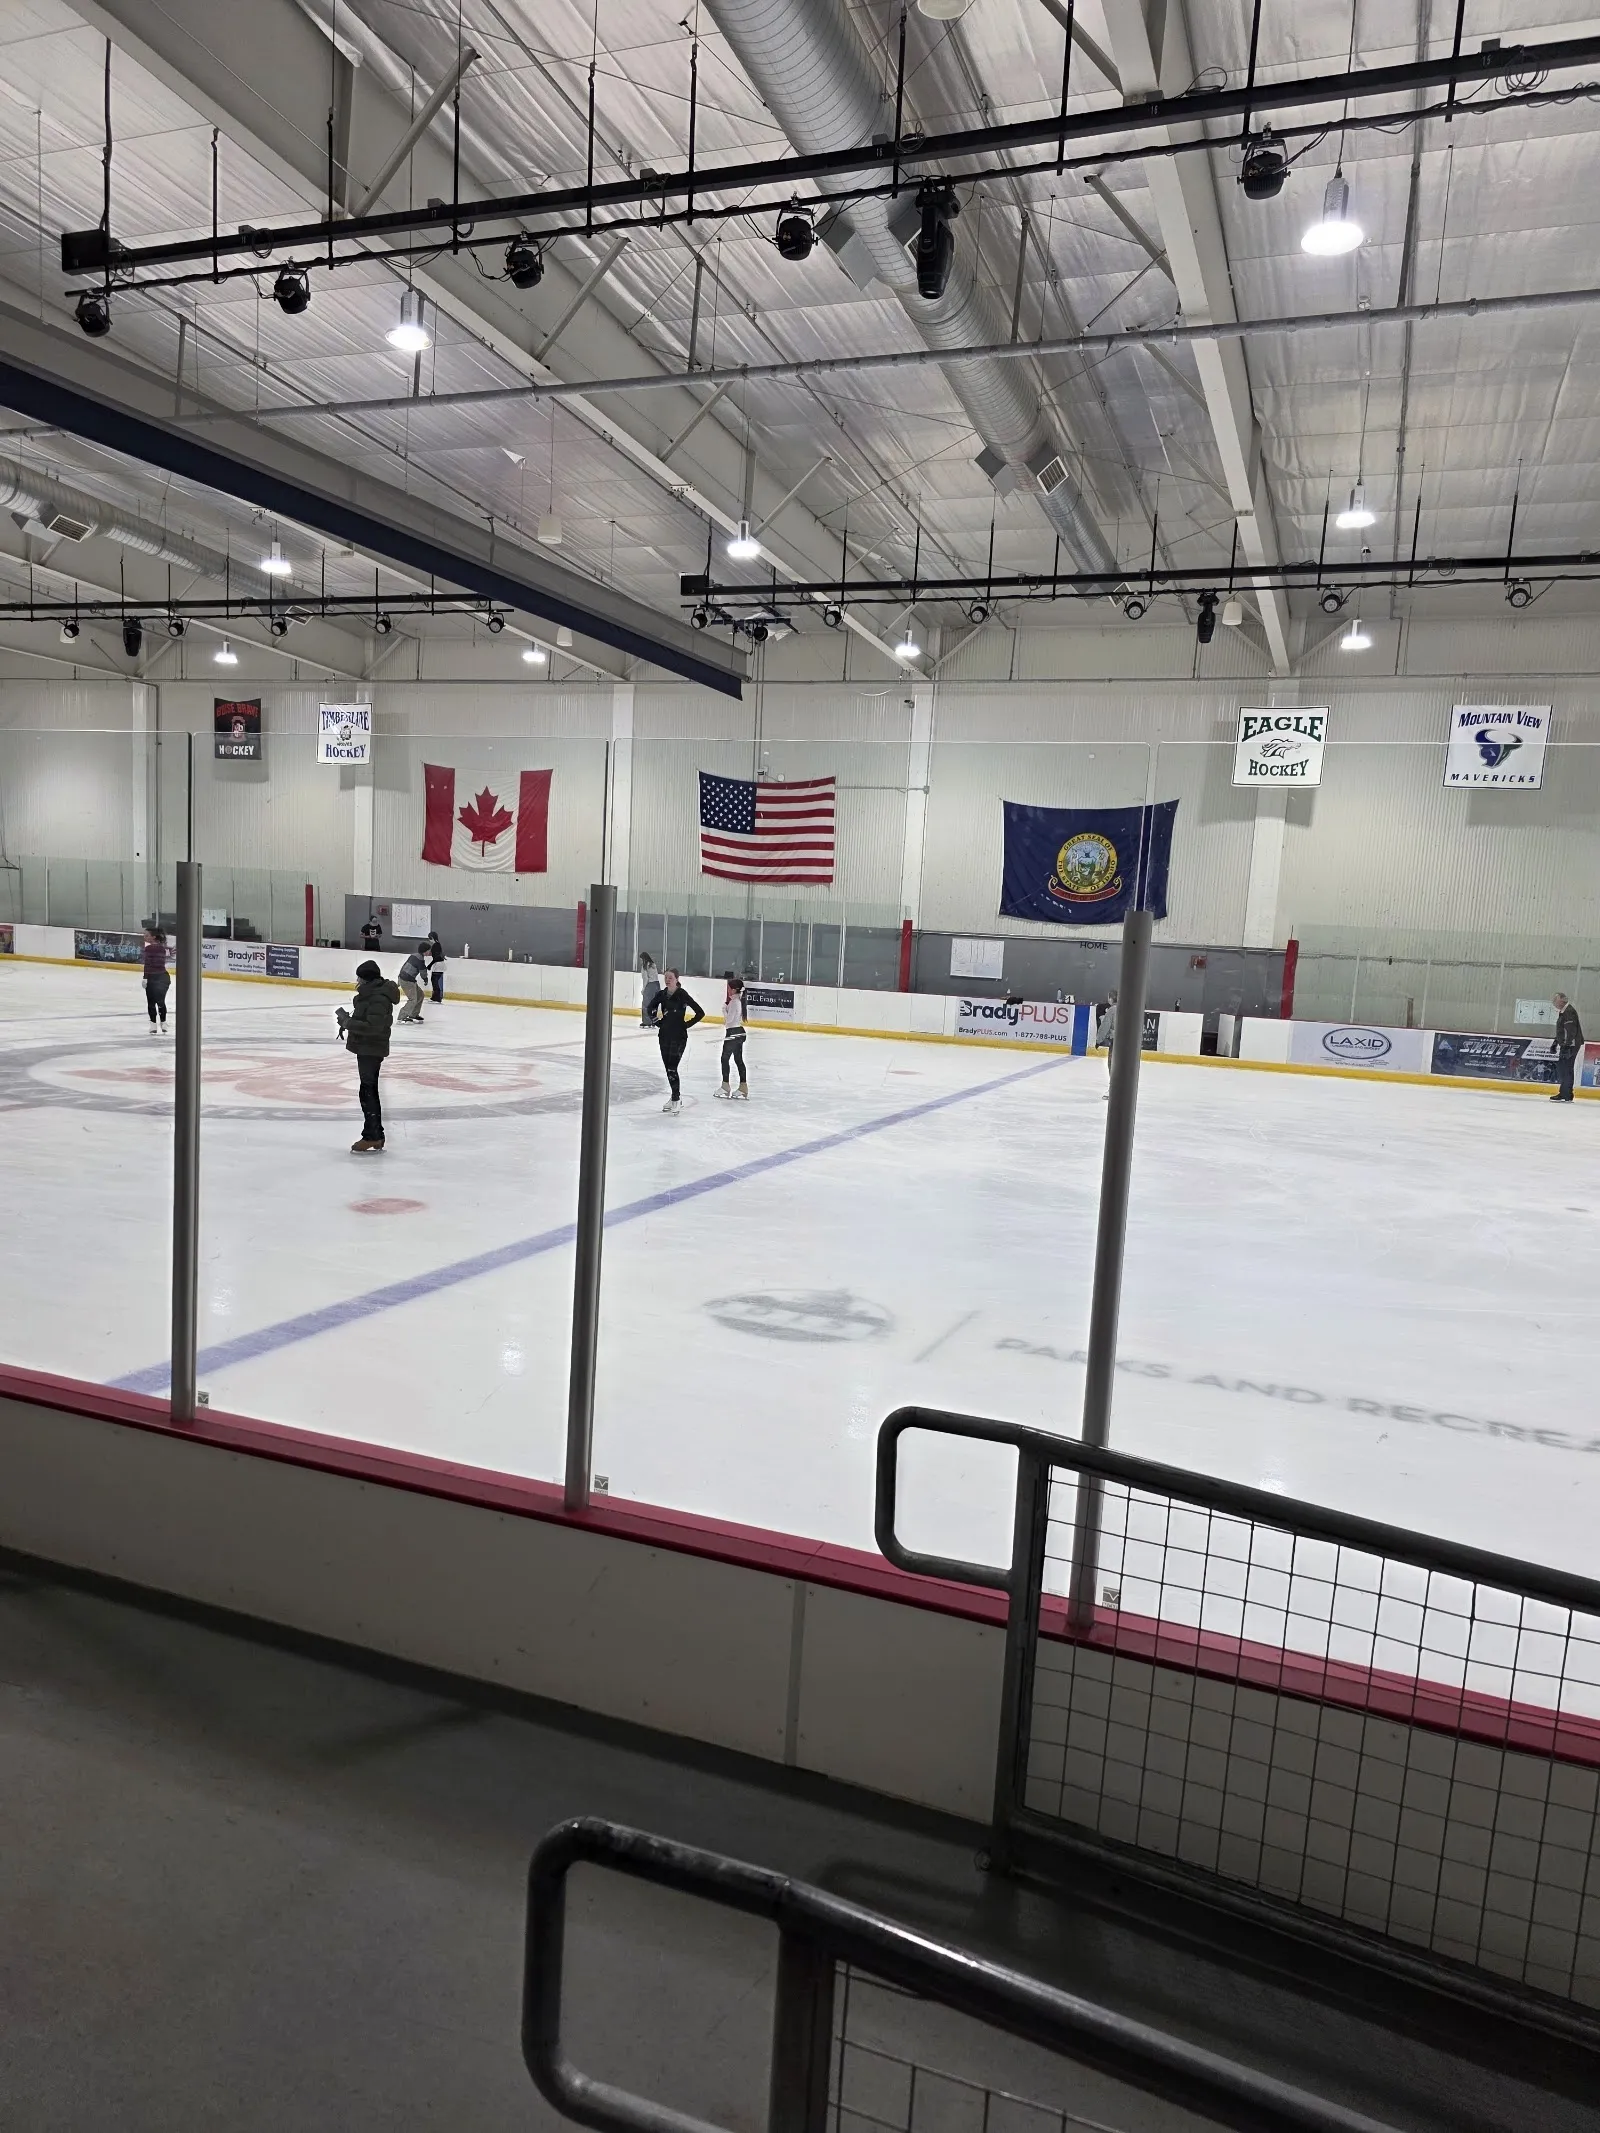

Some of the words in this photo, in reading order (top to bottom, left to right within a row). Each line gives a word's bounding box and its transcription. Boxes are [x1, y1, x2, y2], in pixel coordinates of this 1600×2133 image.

[321, 711, 370, 731] TIMBERLINE
[1458, 712, 1514, 728] MOUNTAIN
[1517, 711, 1543, 729] VIEW
[1241, 716, 1324, 743] EAGLE
[219, 744, 255, 756] HOCKEY
[325, 744, 367, 758] HOCKEY
[1247, 758, 1310, 777] HOCKEY
[1450, 773, 1536, 783] MAVERICKS
[469, 904, 490, 912] AWAY
[1079, 941, 1108, 950] HOME
[958, 1027, 1008, 1038] BradyPLUS.com
[1330, 1035, 1384, 1048] LAXID
[1459, 1041, 1521, 1056] SKATE
[1190, 1374, 1327, 1404] AND
